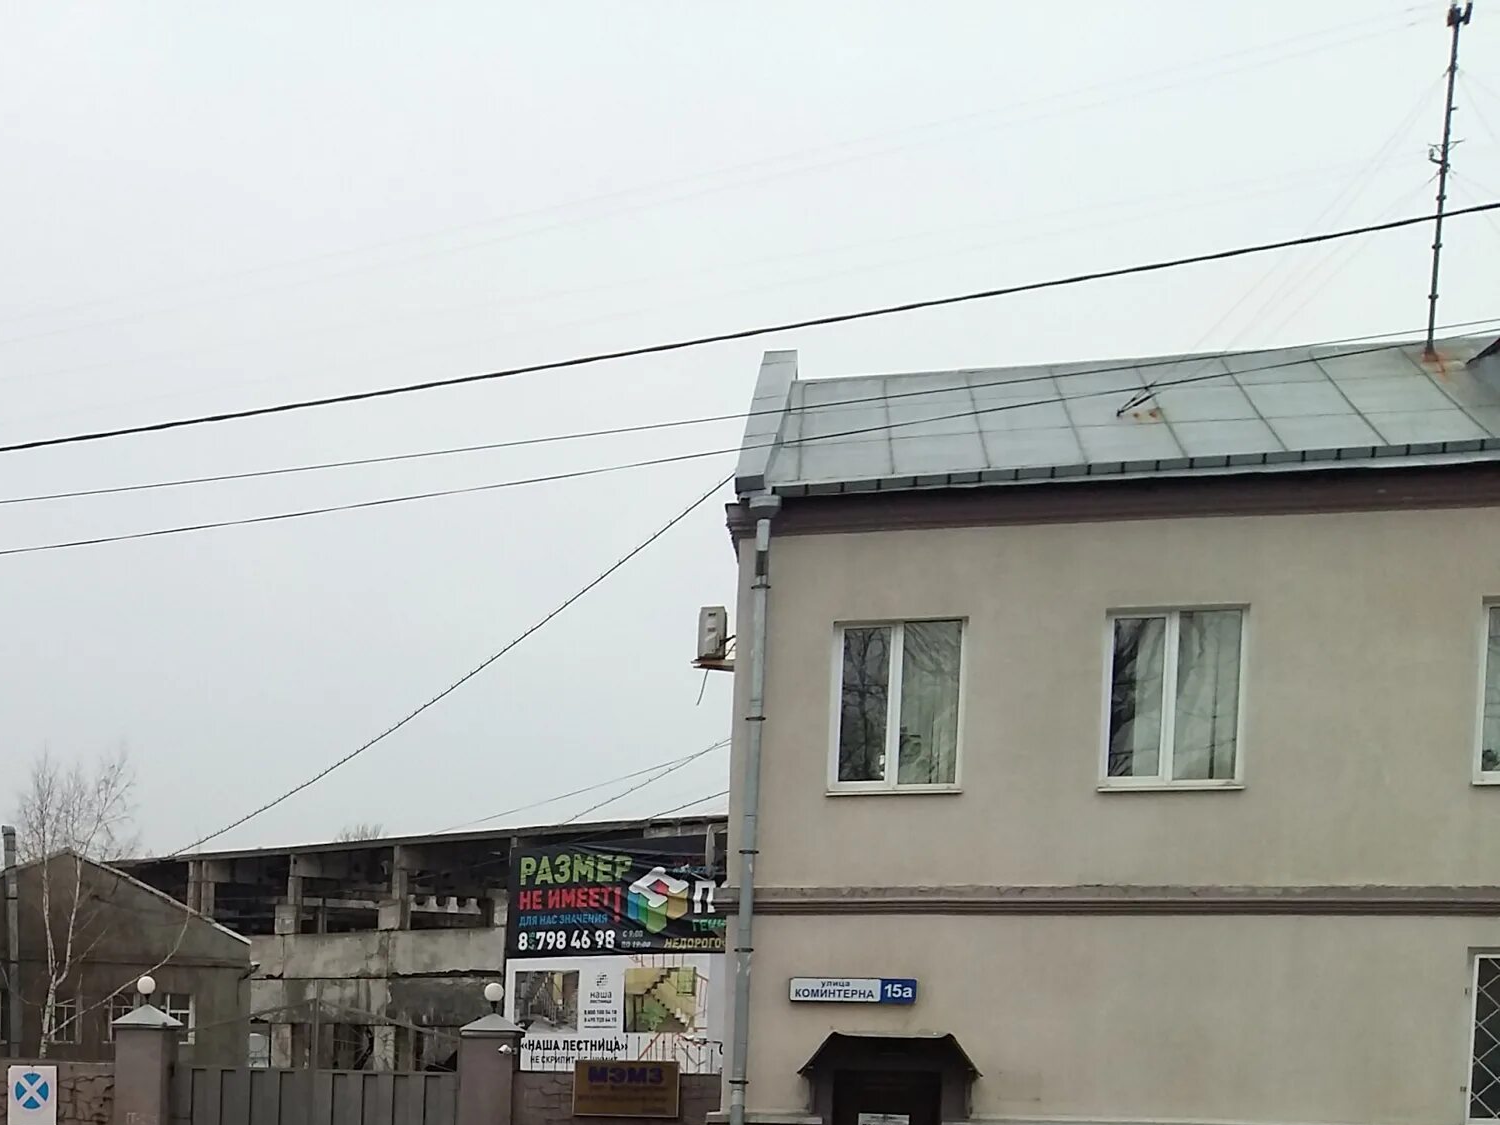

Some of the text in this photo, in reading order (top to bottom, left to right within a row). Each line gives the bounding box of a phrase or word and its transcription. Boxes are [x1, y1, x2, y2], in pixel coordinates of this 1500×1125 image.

[520, 853, 632, 886] РАЗМЕР
[519, 886, 622, 923] НЕ ИМЕЕТ!
[519, 913, 608, 927] ДЛЯ НАС ЗНАЧЕНИЯ
[518, 930, 616, 951] 8 798 46 98
[795, 983, 913, 999] КОМИНТЕРНА 15а
[521, 1039, 628, 1053] «НАША ЛЕСТНИЦА»
[588, 1066, 664, 1083] МЭМЗ
